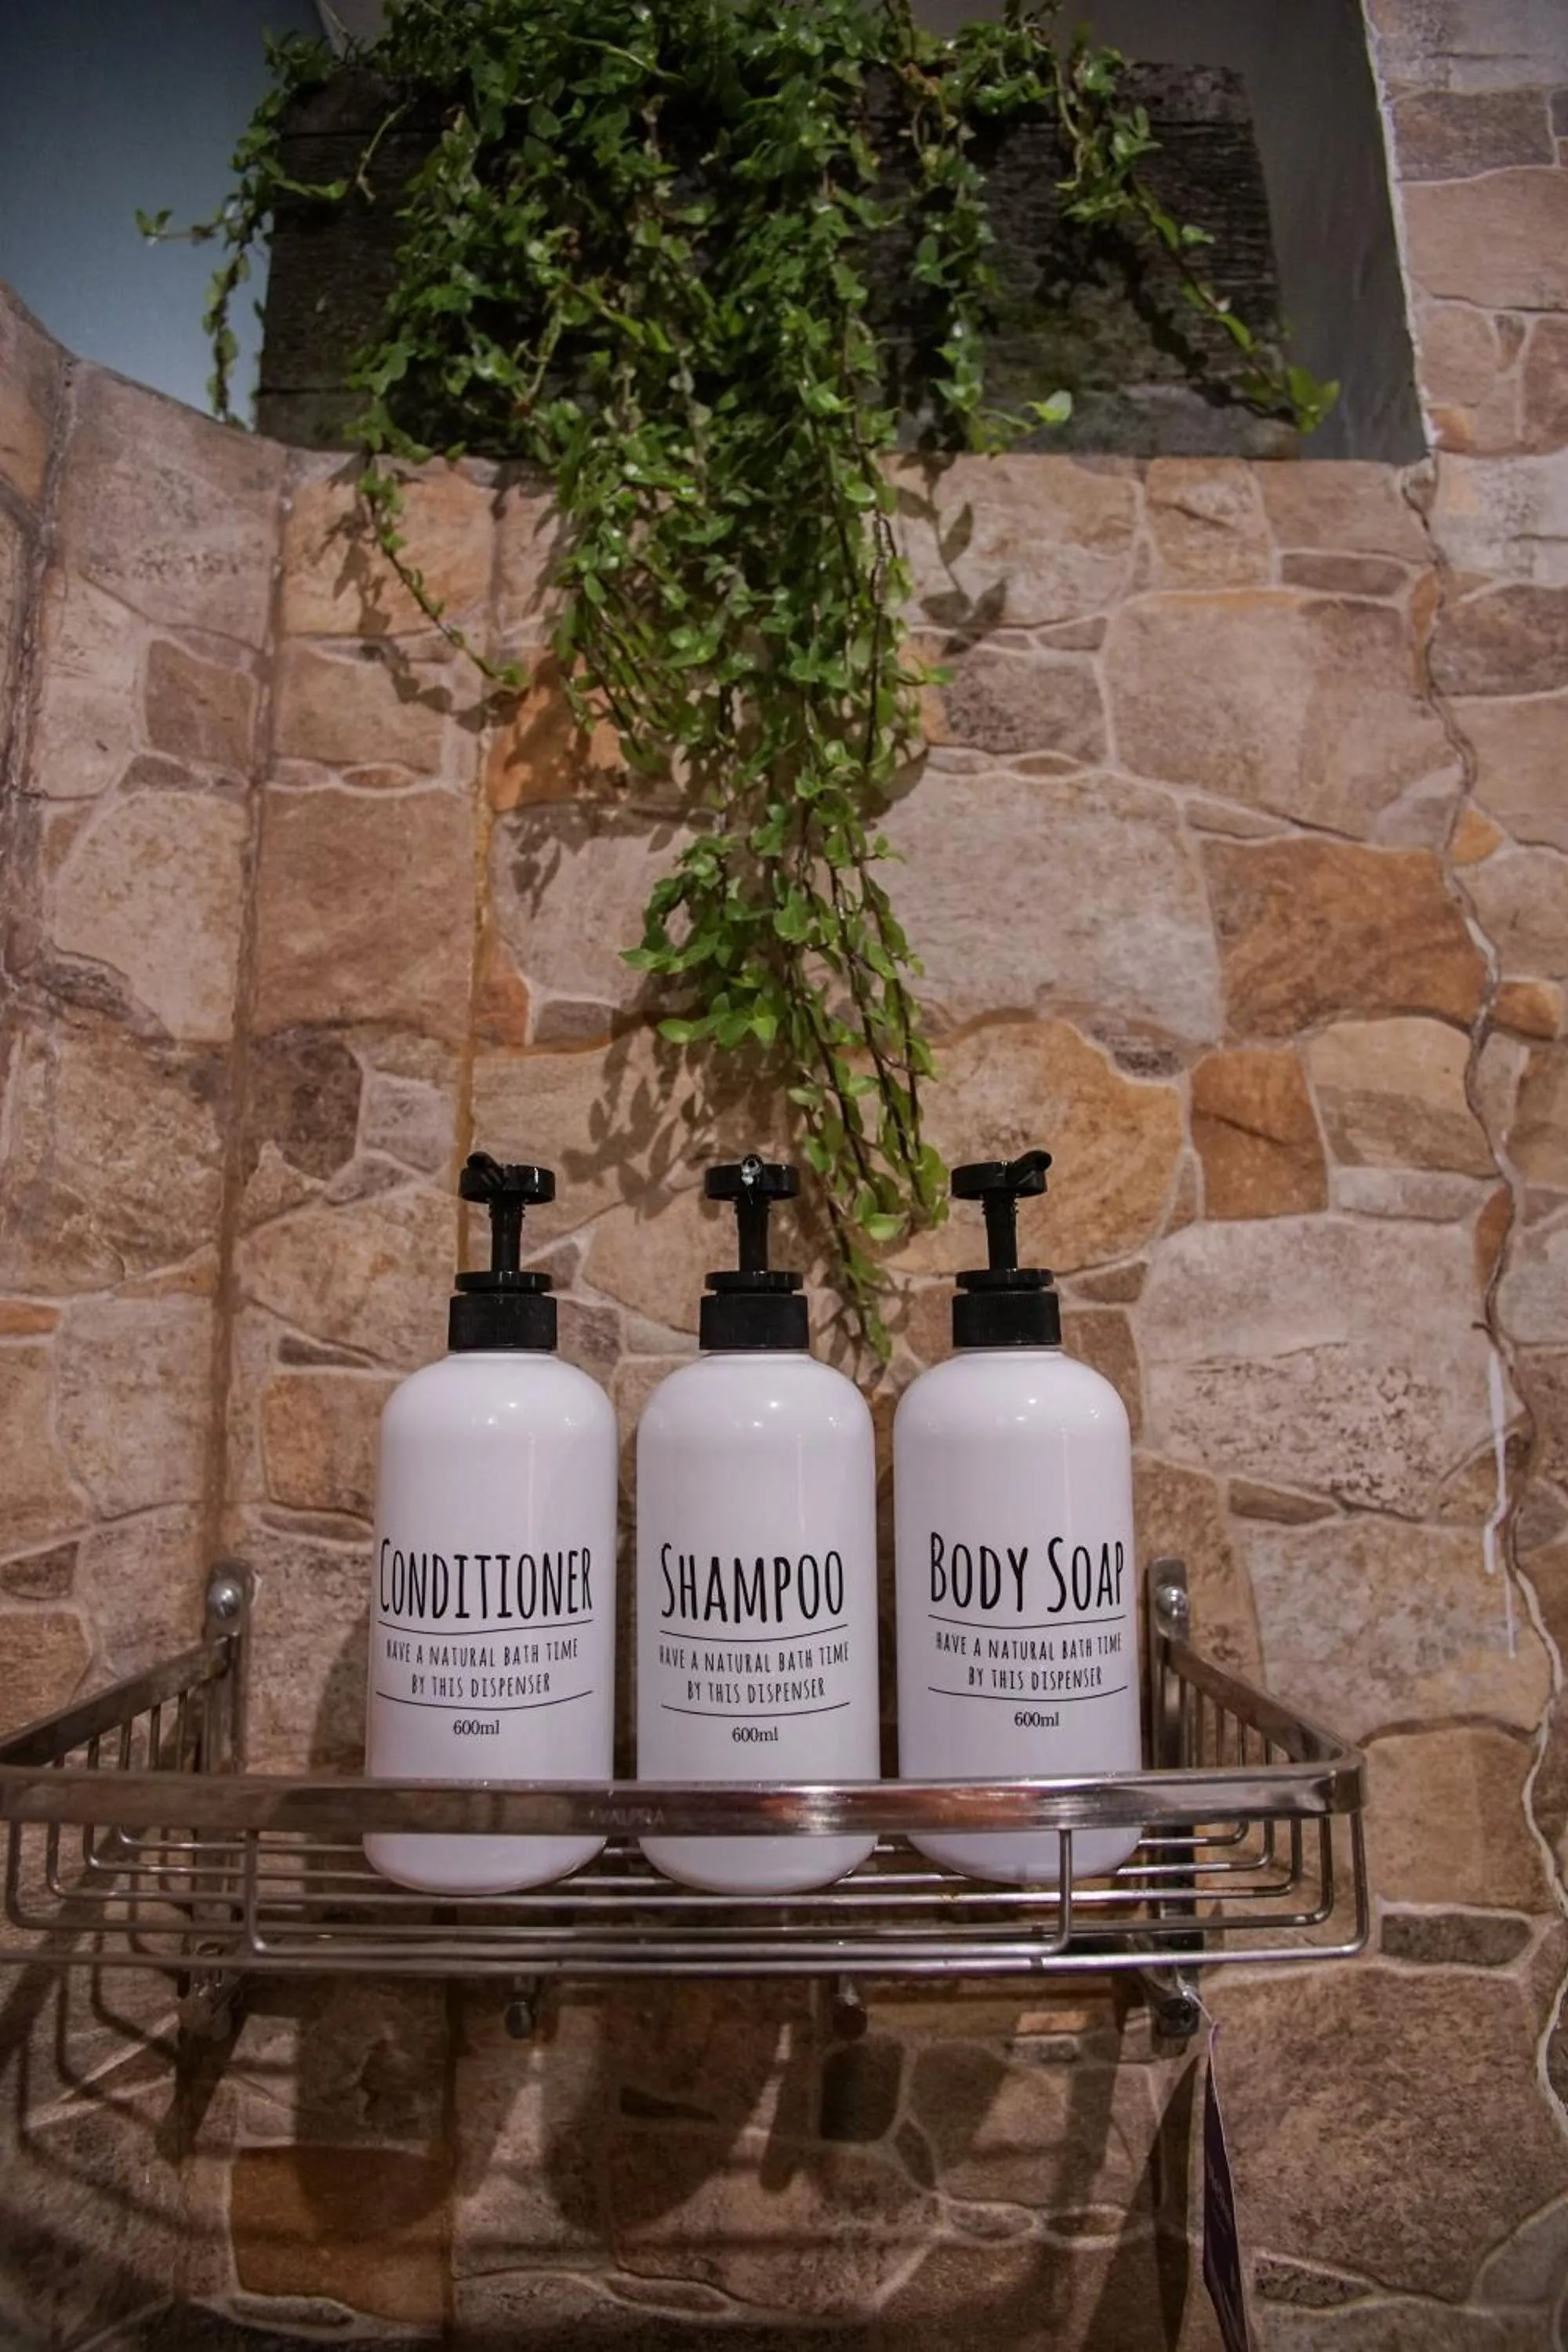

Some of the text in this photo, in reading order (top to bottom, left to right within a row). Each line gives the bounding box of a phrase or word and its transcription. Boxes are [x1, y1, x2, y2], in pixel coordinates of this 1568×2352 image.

[387, 1638, 578, 1668] HAVE A NATURAL BATH TIME
[659, 1642, 849, 1673] HAVE A NATURAL BATH TIME
[936, 1632, 1121, 1661] HAVE A NATURAL BATH TIME
[412, 1672, 550, 1698] BY THIS DISPENSER
[688, 1677, 825, 1704] BY THIS DISPENSER
[968, 1665, 1102, 1690] BY THIS DISPENSER
[453, 1719, 500, 1735] 600ml
[1014, 1711, 1059, 1727] 600ml
[732, 1726, 779, 1742] 600ml
